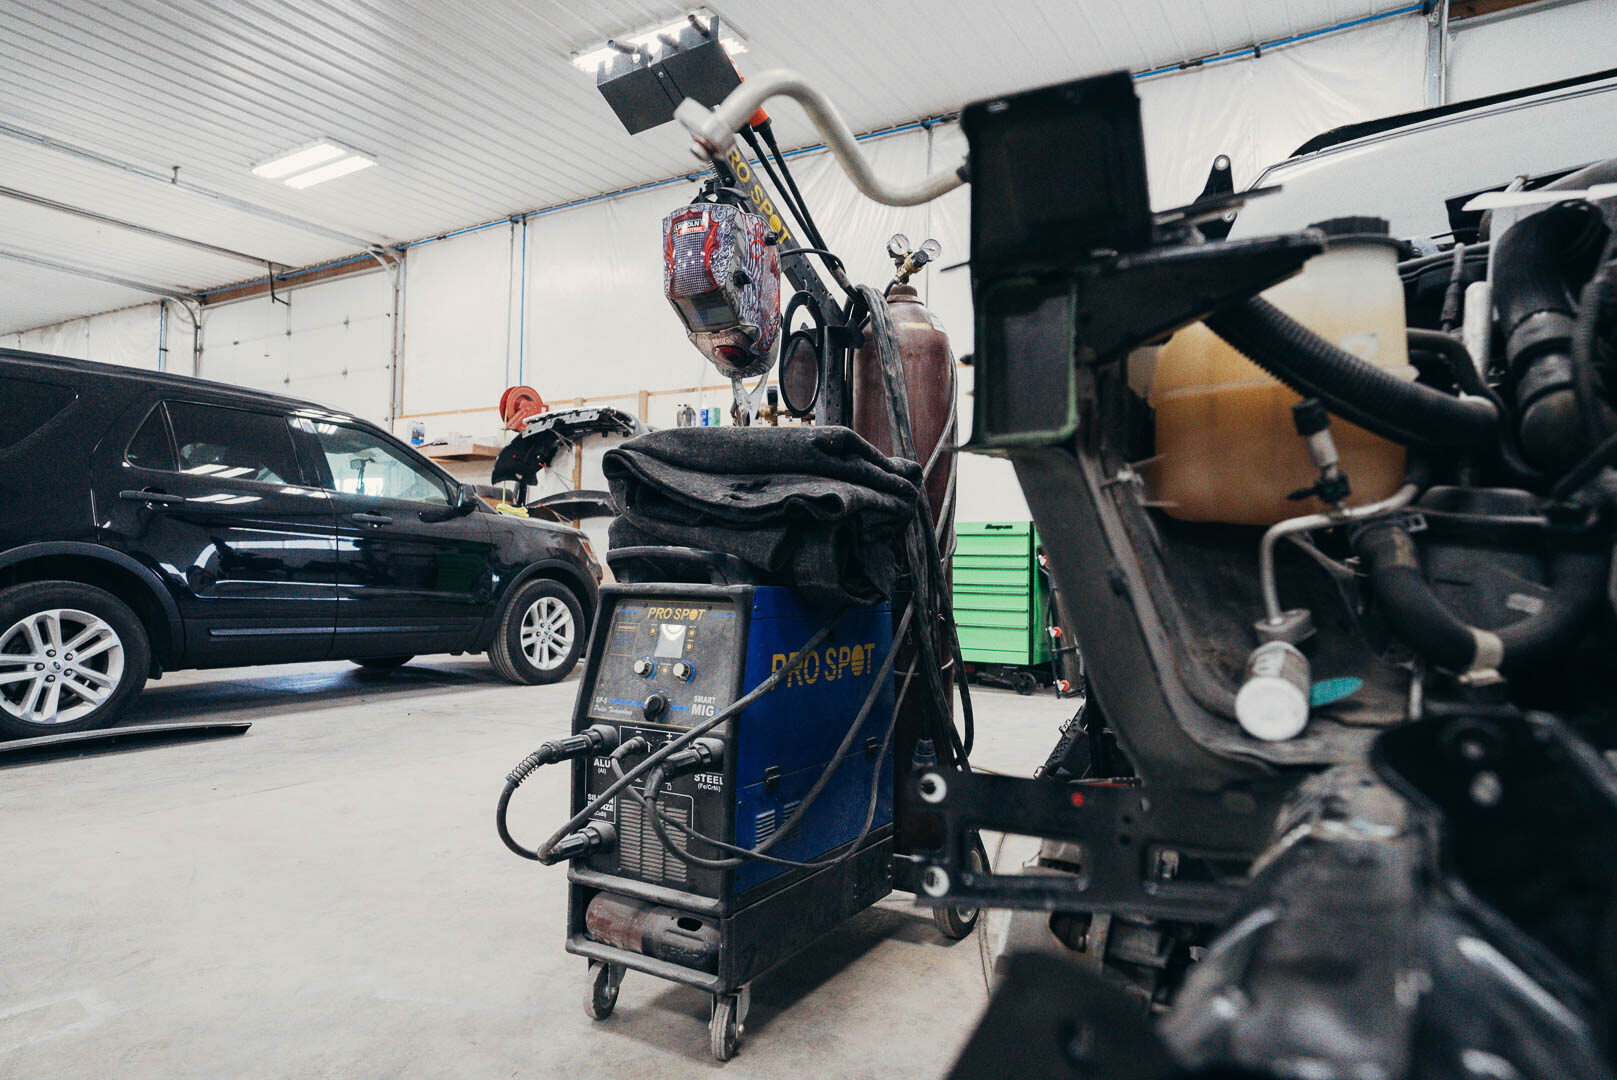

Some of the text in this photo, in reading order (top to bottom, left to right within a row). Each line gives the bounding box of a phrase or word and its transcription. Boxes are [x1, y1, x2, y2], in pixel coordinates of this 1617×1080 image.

[751, 184, 791, 245] SPOT
[673, 219, 701, 232] LIOLN
[647, 607, 672, 620] PRO
[673, 608, 706, 621] SPOT
[770, 643, 876, 692] PRO SPOT
[693, 695, 717, 704] SMART
[691, 703, 715, 717] MIG
[593, 758, 611, 768] ALU
[693, 773, 724, 786] STEEL
[587, 793, 614, 804] SILN
